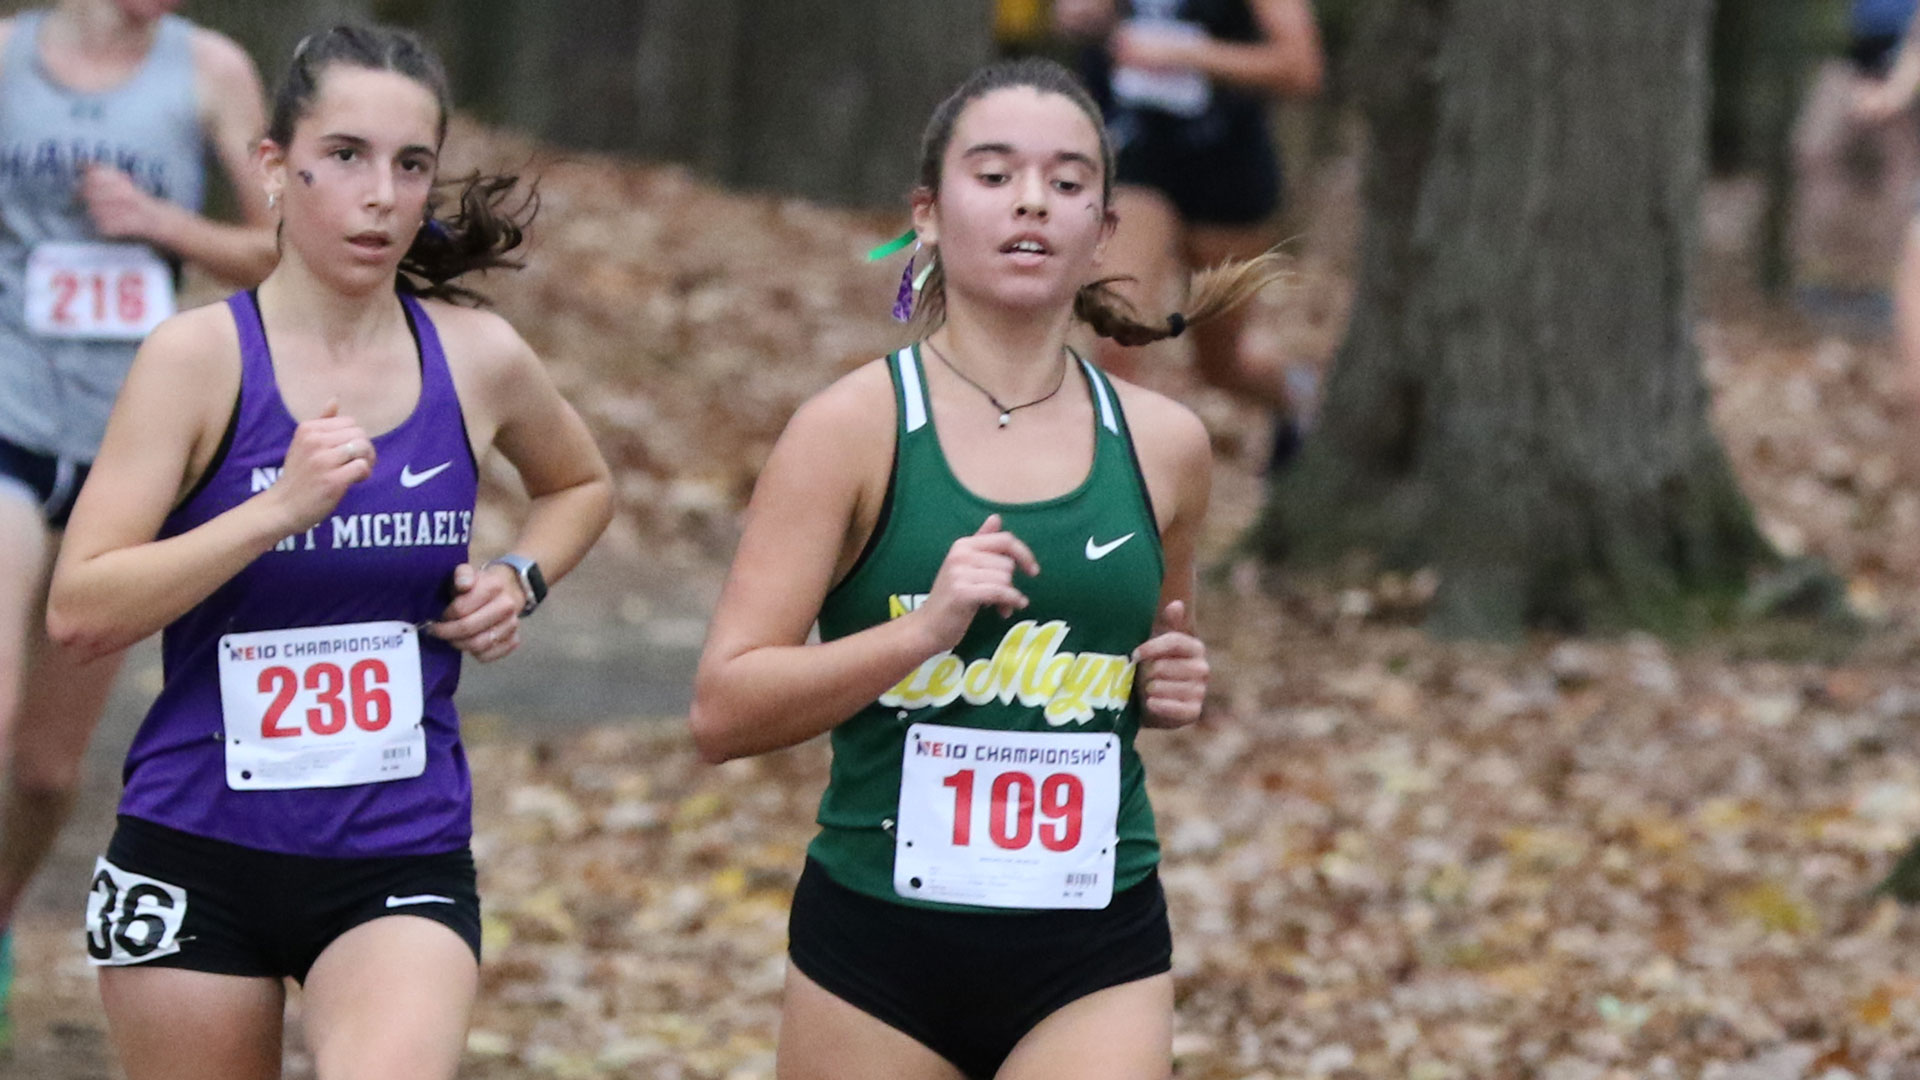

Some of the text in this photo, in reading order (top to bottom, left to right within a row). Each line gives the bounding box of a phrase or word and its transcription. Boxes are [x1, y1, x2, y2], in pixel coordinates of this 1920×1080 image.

[331, 510, 471, 549] MICHAEL'S
[284, 634, 404, 658] CHAMPIONSHIP
[258, 659, 392, 739] 236
[975, 746, 1106, 764] CHAMPIONSHIP
[943, 769, 1084, 852] 109
